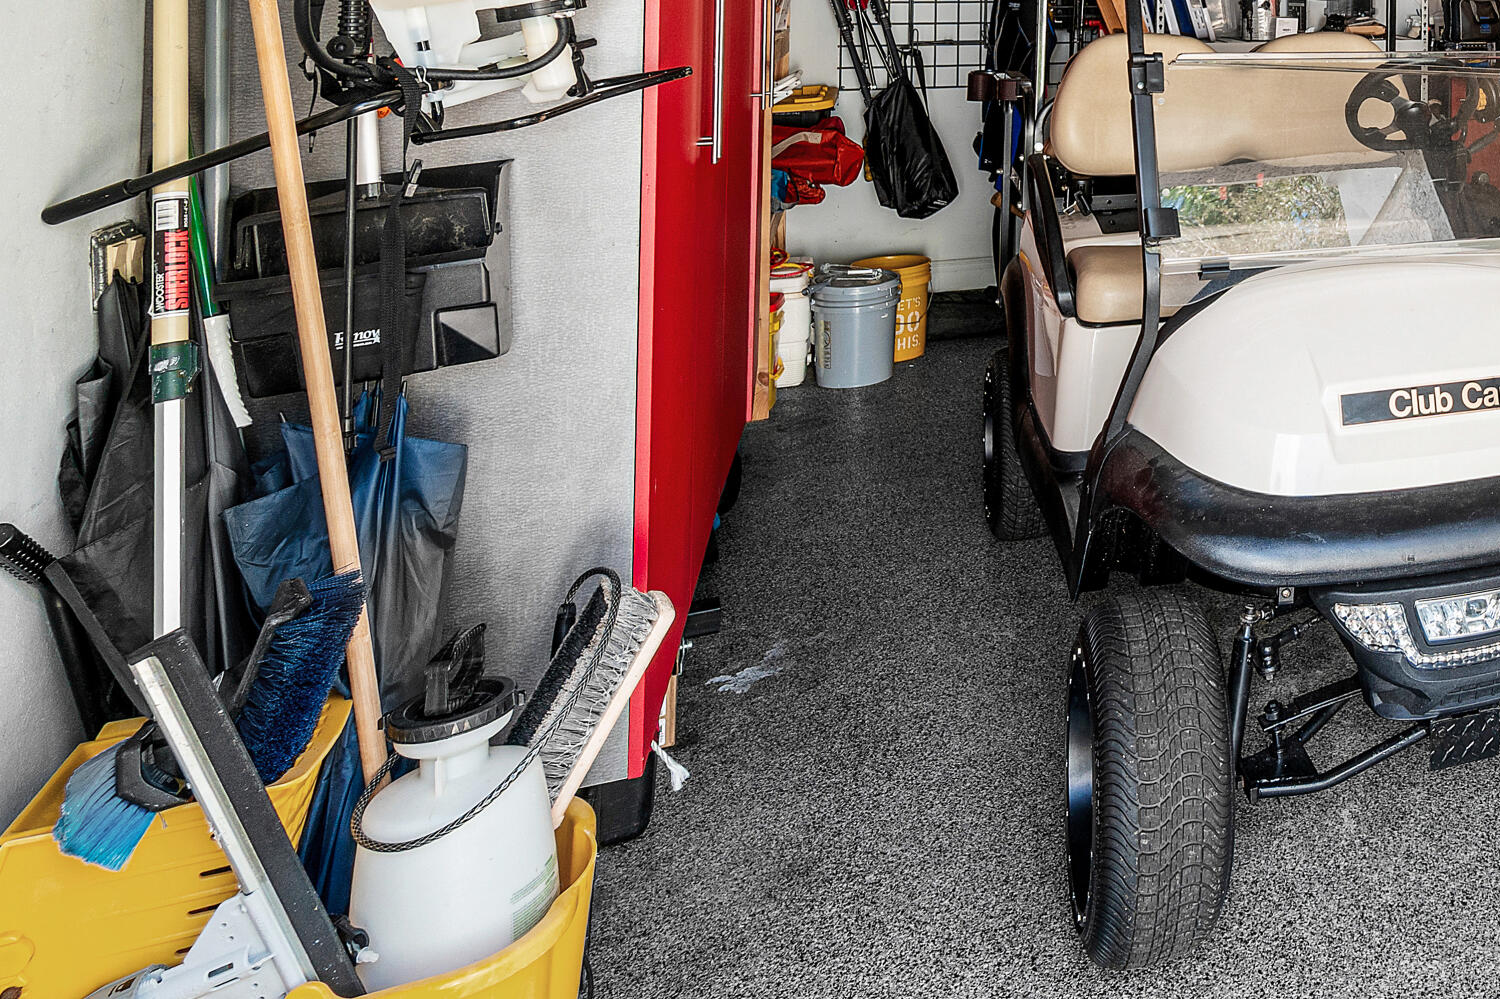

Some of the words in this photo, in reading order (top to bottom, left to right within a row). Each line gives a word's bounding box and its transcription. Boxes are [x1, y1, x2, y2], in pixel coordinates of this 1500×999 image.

[164, 229, 189, 311] SHERLOCK
[155, 272, 165, 312] WOOSTER
[896, 296, 921, 312] ET'S
[896, 333, 921, 352] HIS.
[1389, 386, 1454, 418] Club
